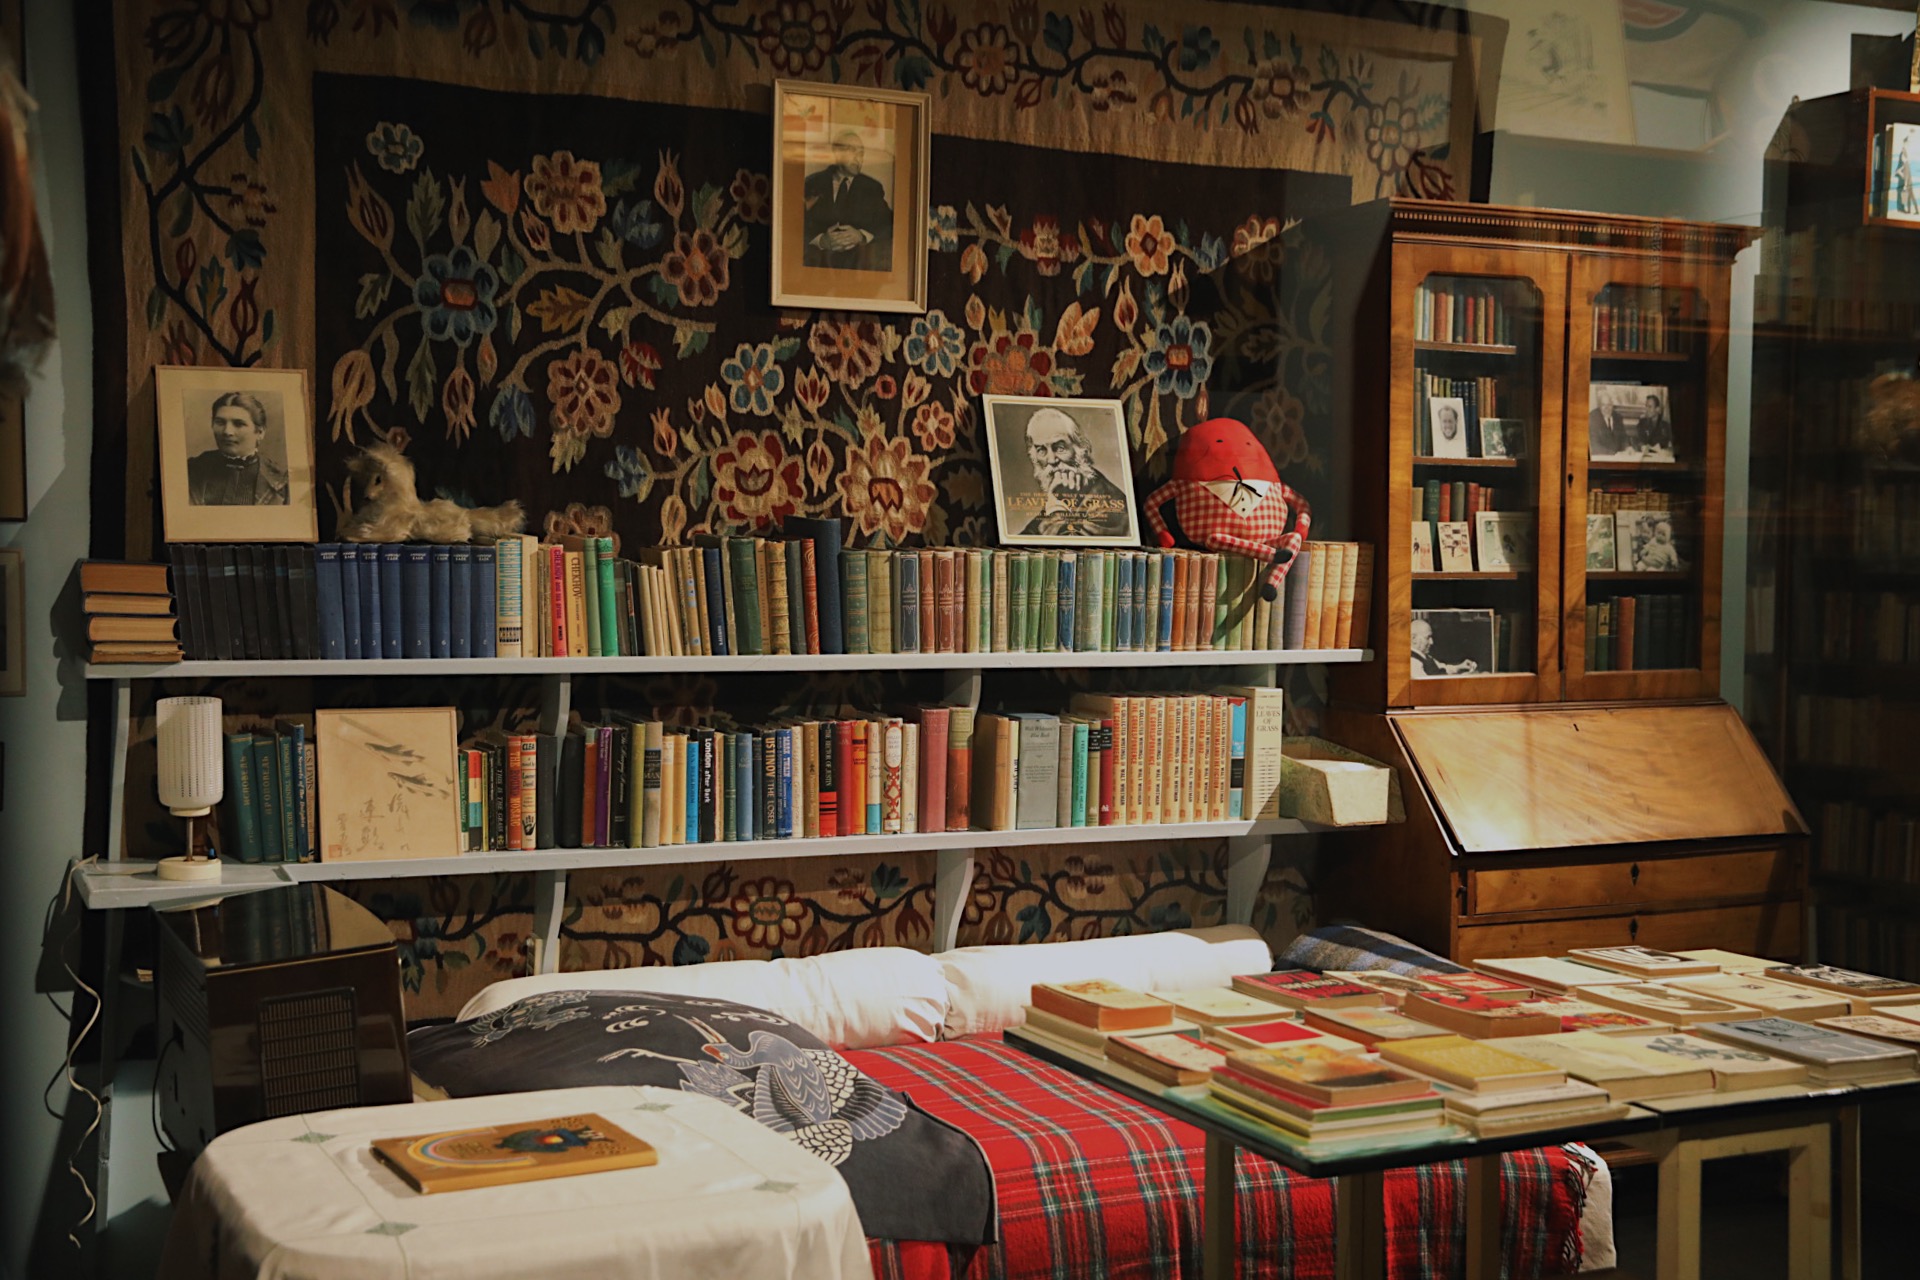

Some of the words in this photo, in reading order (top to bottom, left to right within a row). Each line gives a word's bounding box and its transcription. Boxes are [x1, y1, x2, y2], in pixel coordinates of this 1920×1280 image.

[1007, 496, 1056, 508] LEAVE
[1063, 498, 1079, 508] OF
[1083, 498, 1126, 509] GRASS
[571, 557, 582, 597] CHEKHOV
[522, 743, 535, 751] CLEA
[704, 738, 712, 768] London
[765, 737, 776, 777] USTINOV
[782, 736, 790, 755] MARK
[510, 751, 520, 767] THE
[783, 757, 791, 778] TWAIN
[239, 755, 251, 806] ИСПОВЕДЬ
[262, 755, 272, 815] ПРОПОВЕДЬ
[767, 784, 775, 798] THE
[510, 797, 520, 827] MOSAIC
[767, 800, 775, 825] LOSER
